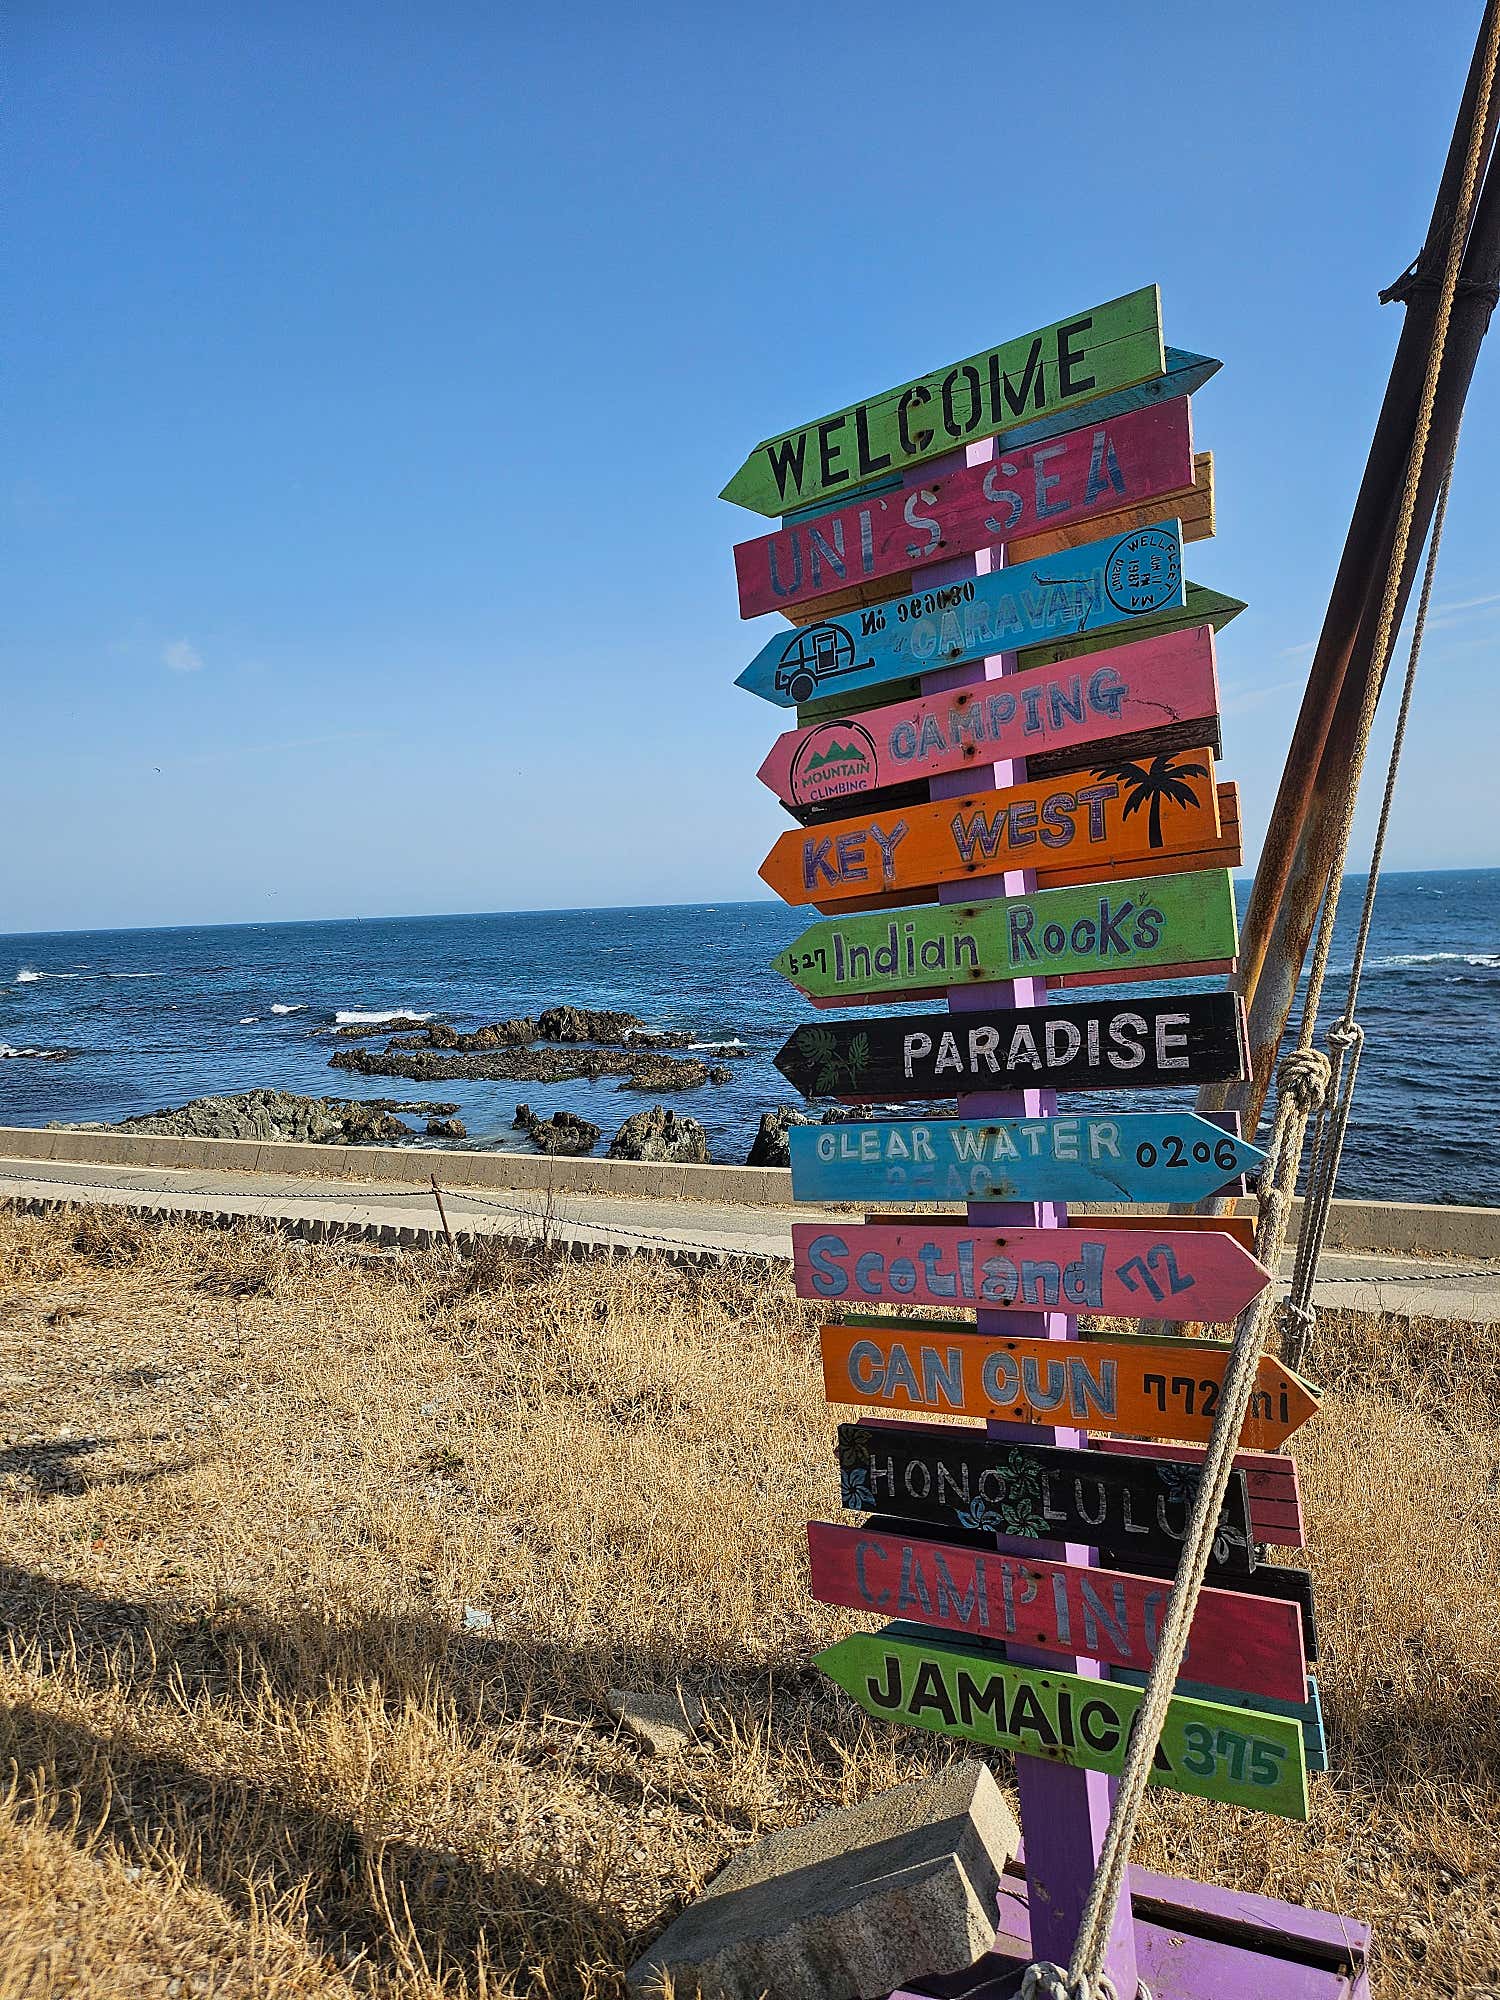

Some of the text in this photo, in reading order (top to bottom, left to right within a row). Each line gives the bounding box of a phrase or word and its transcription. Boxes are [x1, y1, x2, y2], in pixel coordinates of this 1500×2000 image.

[768, 317, 1096, 502] WELCOME
[768, 432, 1127, 597] UNI'S SEA
[911, 567, 1105, 659] CARAVAN
[888, 667, 1129, 766] CAMPING
[802, 762, 870, 788] MOUNTAIN
[810, 780, 868, 800] CLIMBING
[802, 781, 1119, 891] KEY WEST
[789, 948, 826, 975] 527
[832, 922, 979, 983] Indian
[902, 1012, 1191, 1079] PARADISE
[817, 1120, 1238, 1171] CLEAR WATER 0206
[808, 1233, 1196, 1308] Scotland 72
[848, 1339, 965, 1409] CAN
[981, 1351, 1118, 1420] CUN
[1144, 1374, 1220, 1417] 772
[870, 1454, 1193, 1541] HONOLULU
[1183, 1722, 1287, 1785] 375
